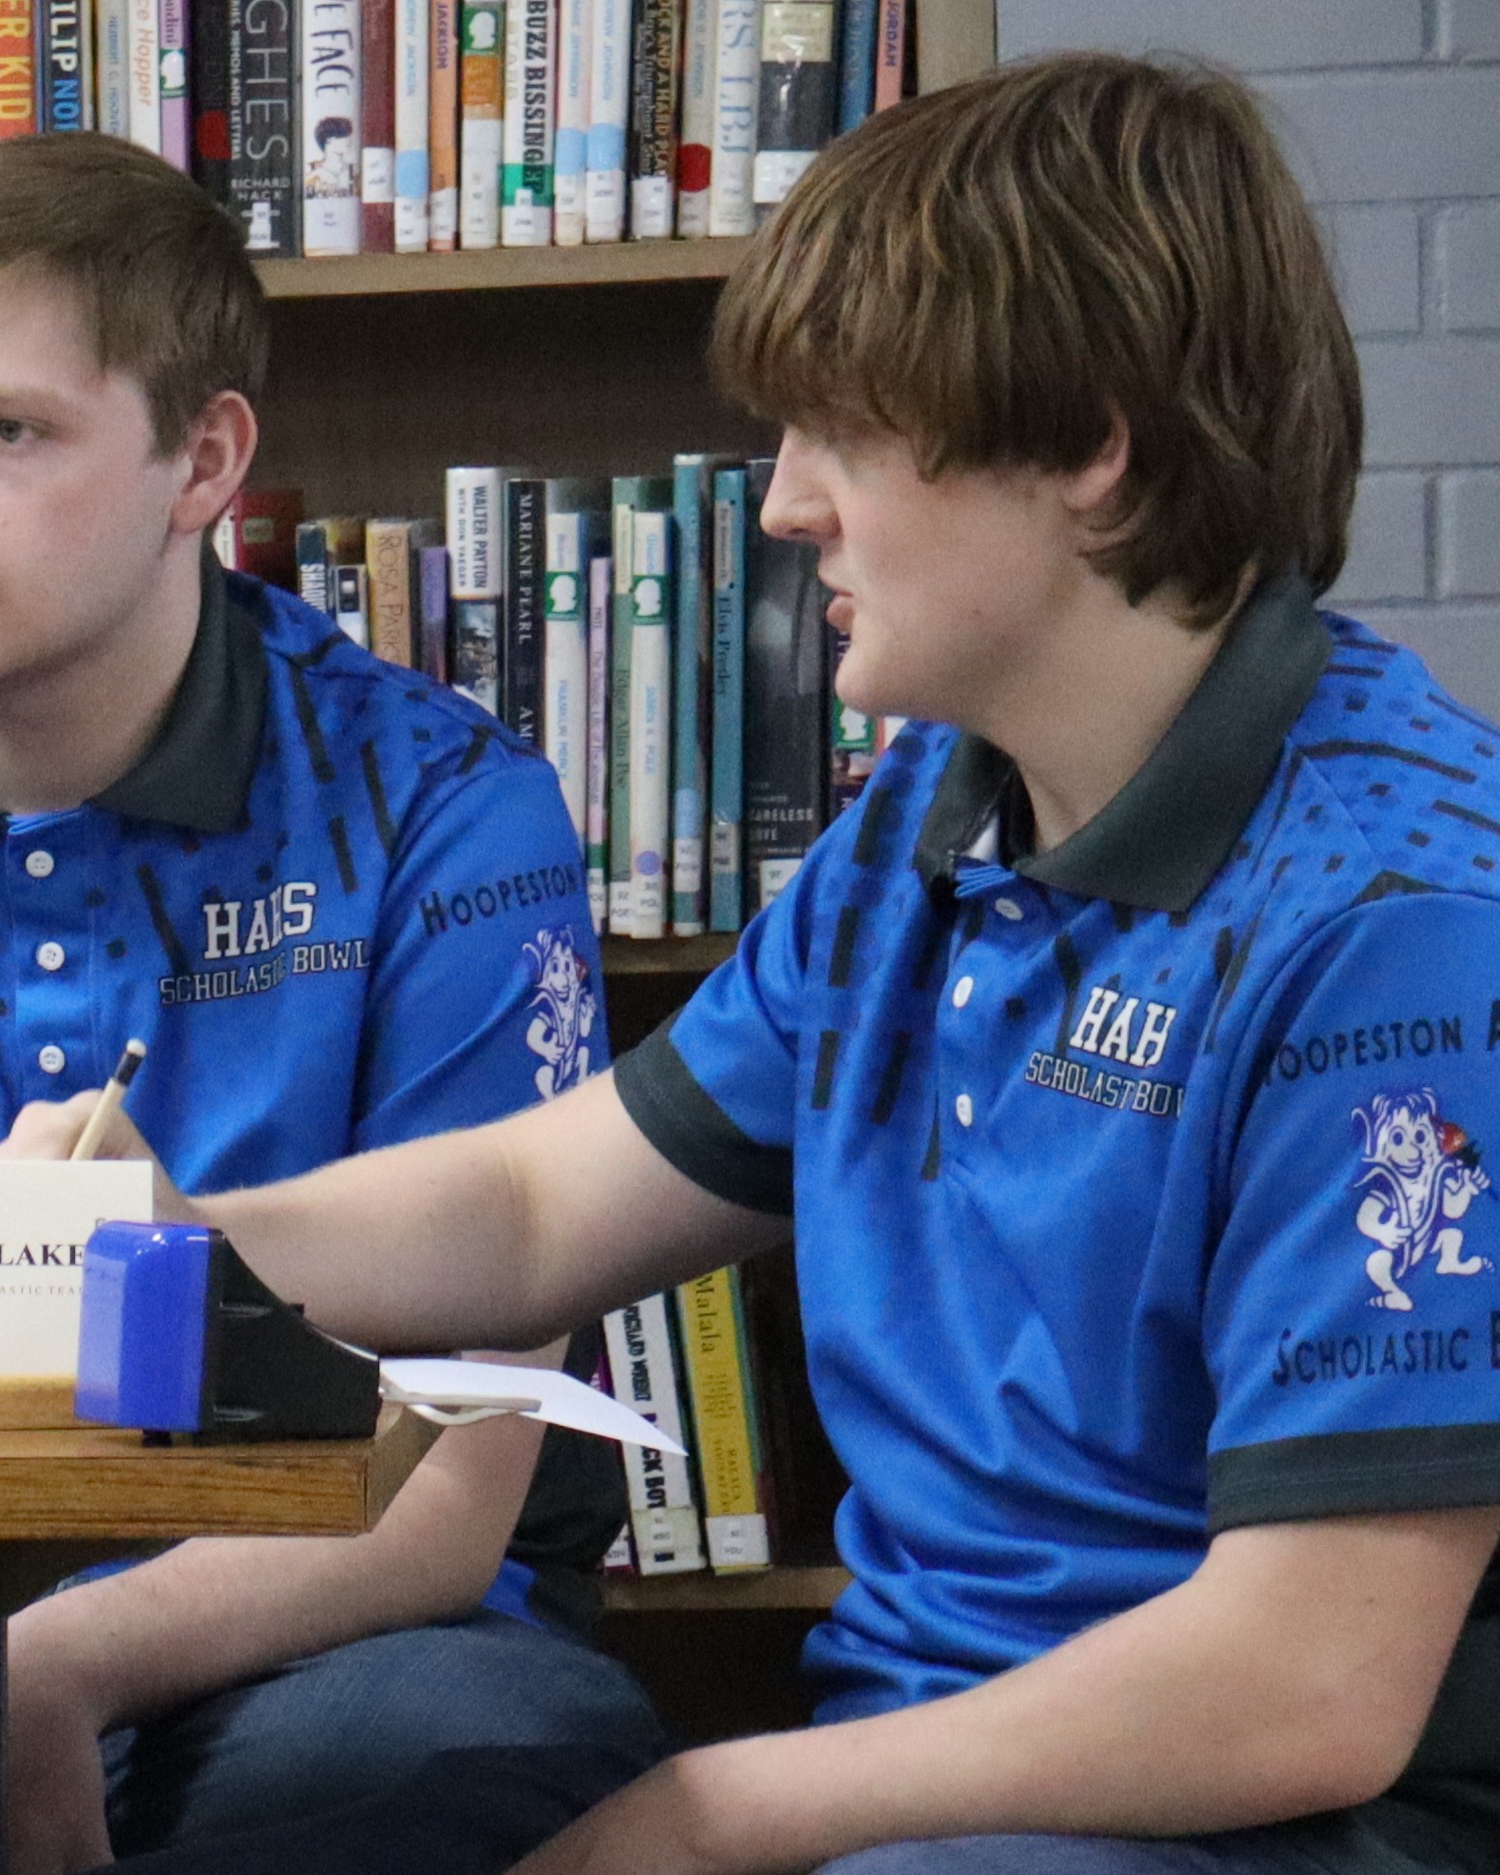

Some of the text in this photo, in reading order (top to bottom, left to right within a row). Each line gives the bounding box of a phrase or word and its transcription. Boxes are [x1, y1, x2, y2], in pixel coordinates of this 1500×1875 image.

[133, 27, 154, 107] Hopper
[458, 488, 466, 514] WITH
[377, 535, 401, 594] ROSA
[472, 486, 489, 589] WALTER PAYTON
[518, 493, 533, 645] MARIANE PEARL
[716, 596, 733, 636] Elvis
[614, 669, 632, 764] Edgar Allan
[418, 864, 579, 937] HOOPESTON
[291, 938, 371, 975] BOWL
[695, 1276, 720, 1353] Malala
[1271, 1326, 1471, 1387] SCHOLASTIC
[646, 1476, 667, 1509] BOY
